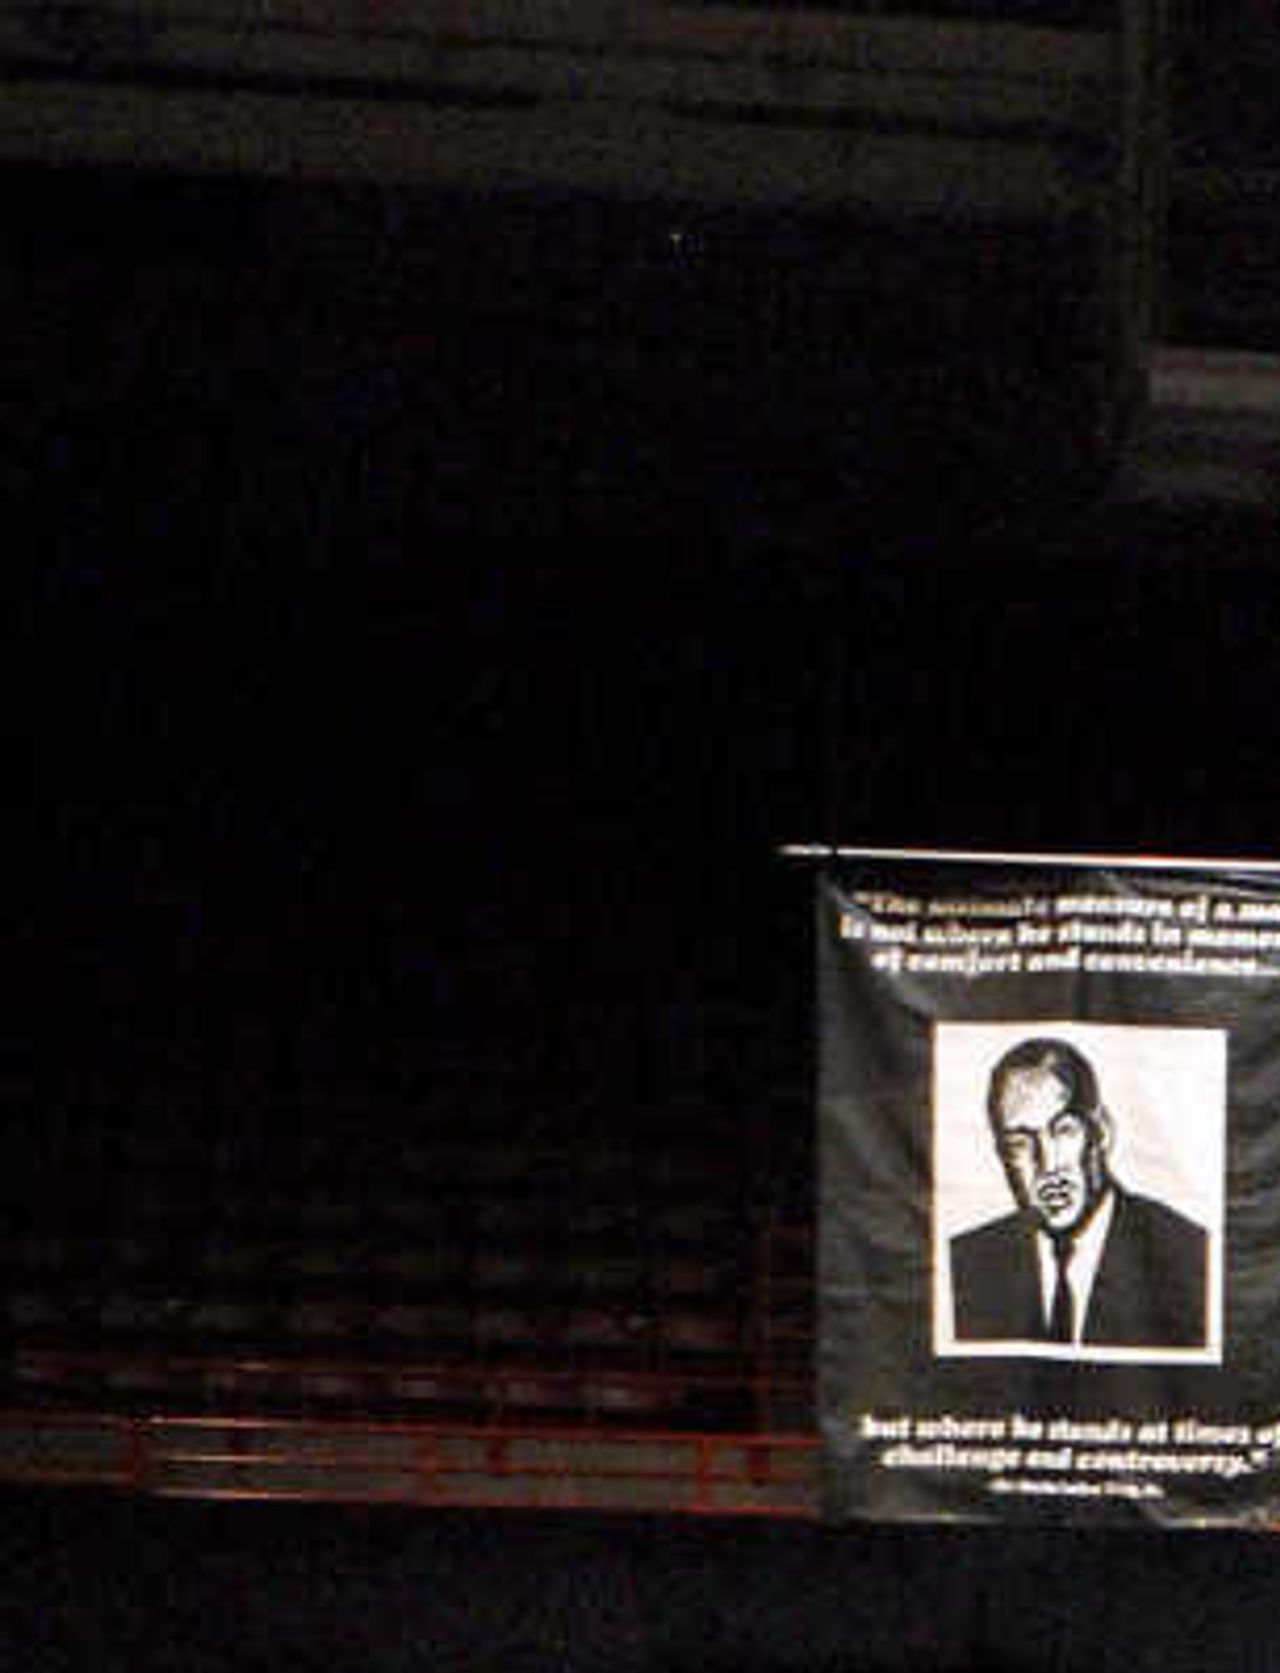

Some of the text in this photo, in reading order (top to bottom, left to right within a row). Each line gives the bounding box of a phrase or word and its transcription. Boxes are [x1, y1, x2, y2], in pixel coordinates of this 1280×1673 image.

[1179, 894, 1209, 923] of
[870, 917, 918, 942] not
[1016, 919, 1052, 943] he
[1058, 918, 1146, 943] stands
[1150, 919, 1182, 945] in
[871, 947, 904, 972] of
[907, 946, 1021, 977] comfort
[1027, 945, 1081, 971] and
[861, 1413, 910, 1440] but
[915, 1414, 1006, 1440] where
[1012, 1413, 1043, 1440] he
[1048, 1416, 1132, 1442] stands
[1137, 1420, 1169, 1443] at
[1173, 1417, 1251, 1443] times
[881, 1442, 1021, 1473] challenge
[1026, 1447, 1073, 1470] and
